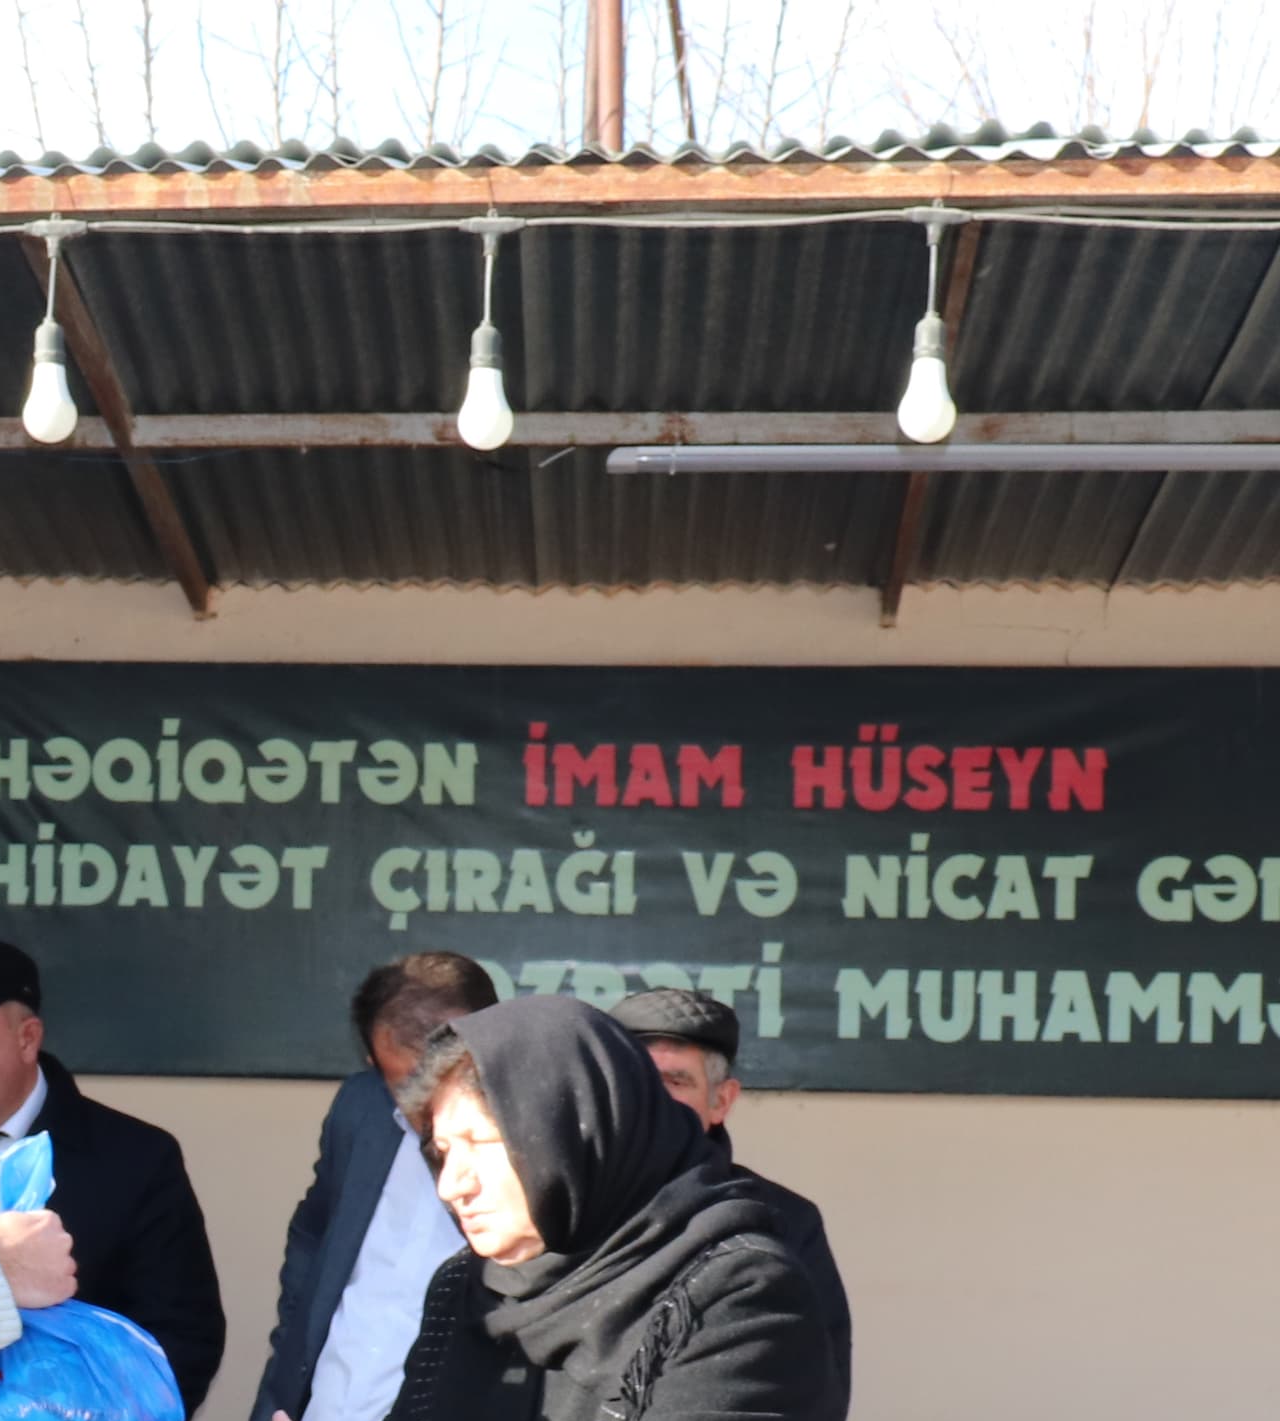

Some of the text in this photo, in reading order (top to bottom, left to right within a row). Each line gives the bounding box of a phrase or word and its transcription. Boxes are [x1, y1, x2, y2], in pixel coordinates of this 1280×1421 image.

[523, 720, 746, 807] İMAM
[790, 723, 1108, 811] HÜSEYN
[370, 829, 637, 931] ÇIRAĞI
[682, 850, 798, 917] VƏ
[842, 832, 1094, 921] NİCAT
[1136, 854, 1280, 923] GƏ
[834, 968, 1280, 1044] MUHAMM
